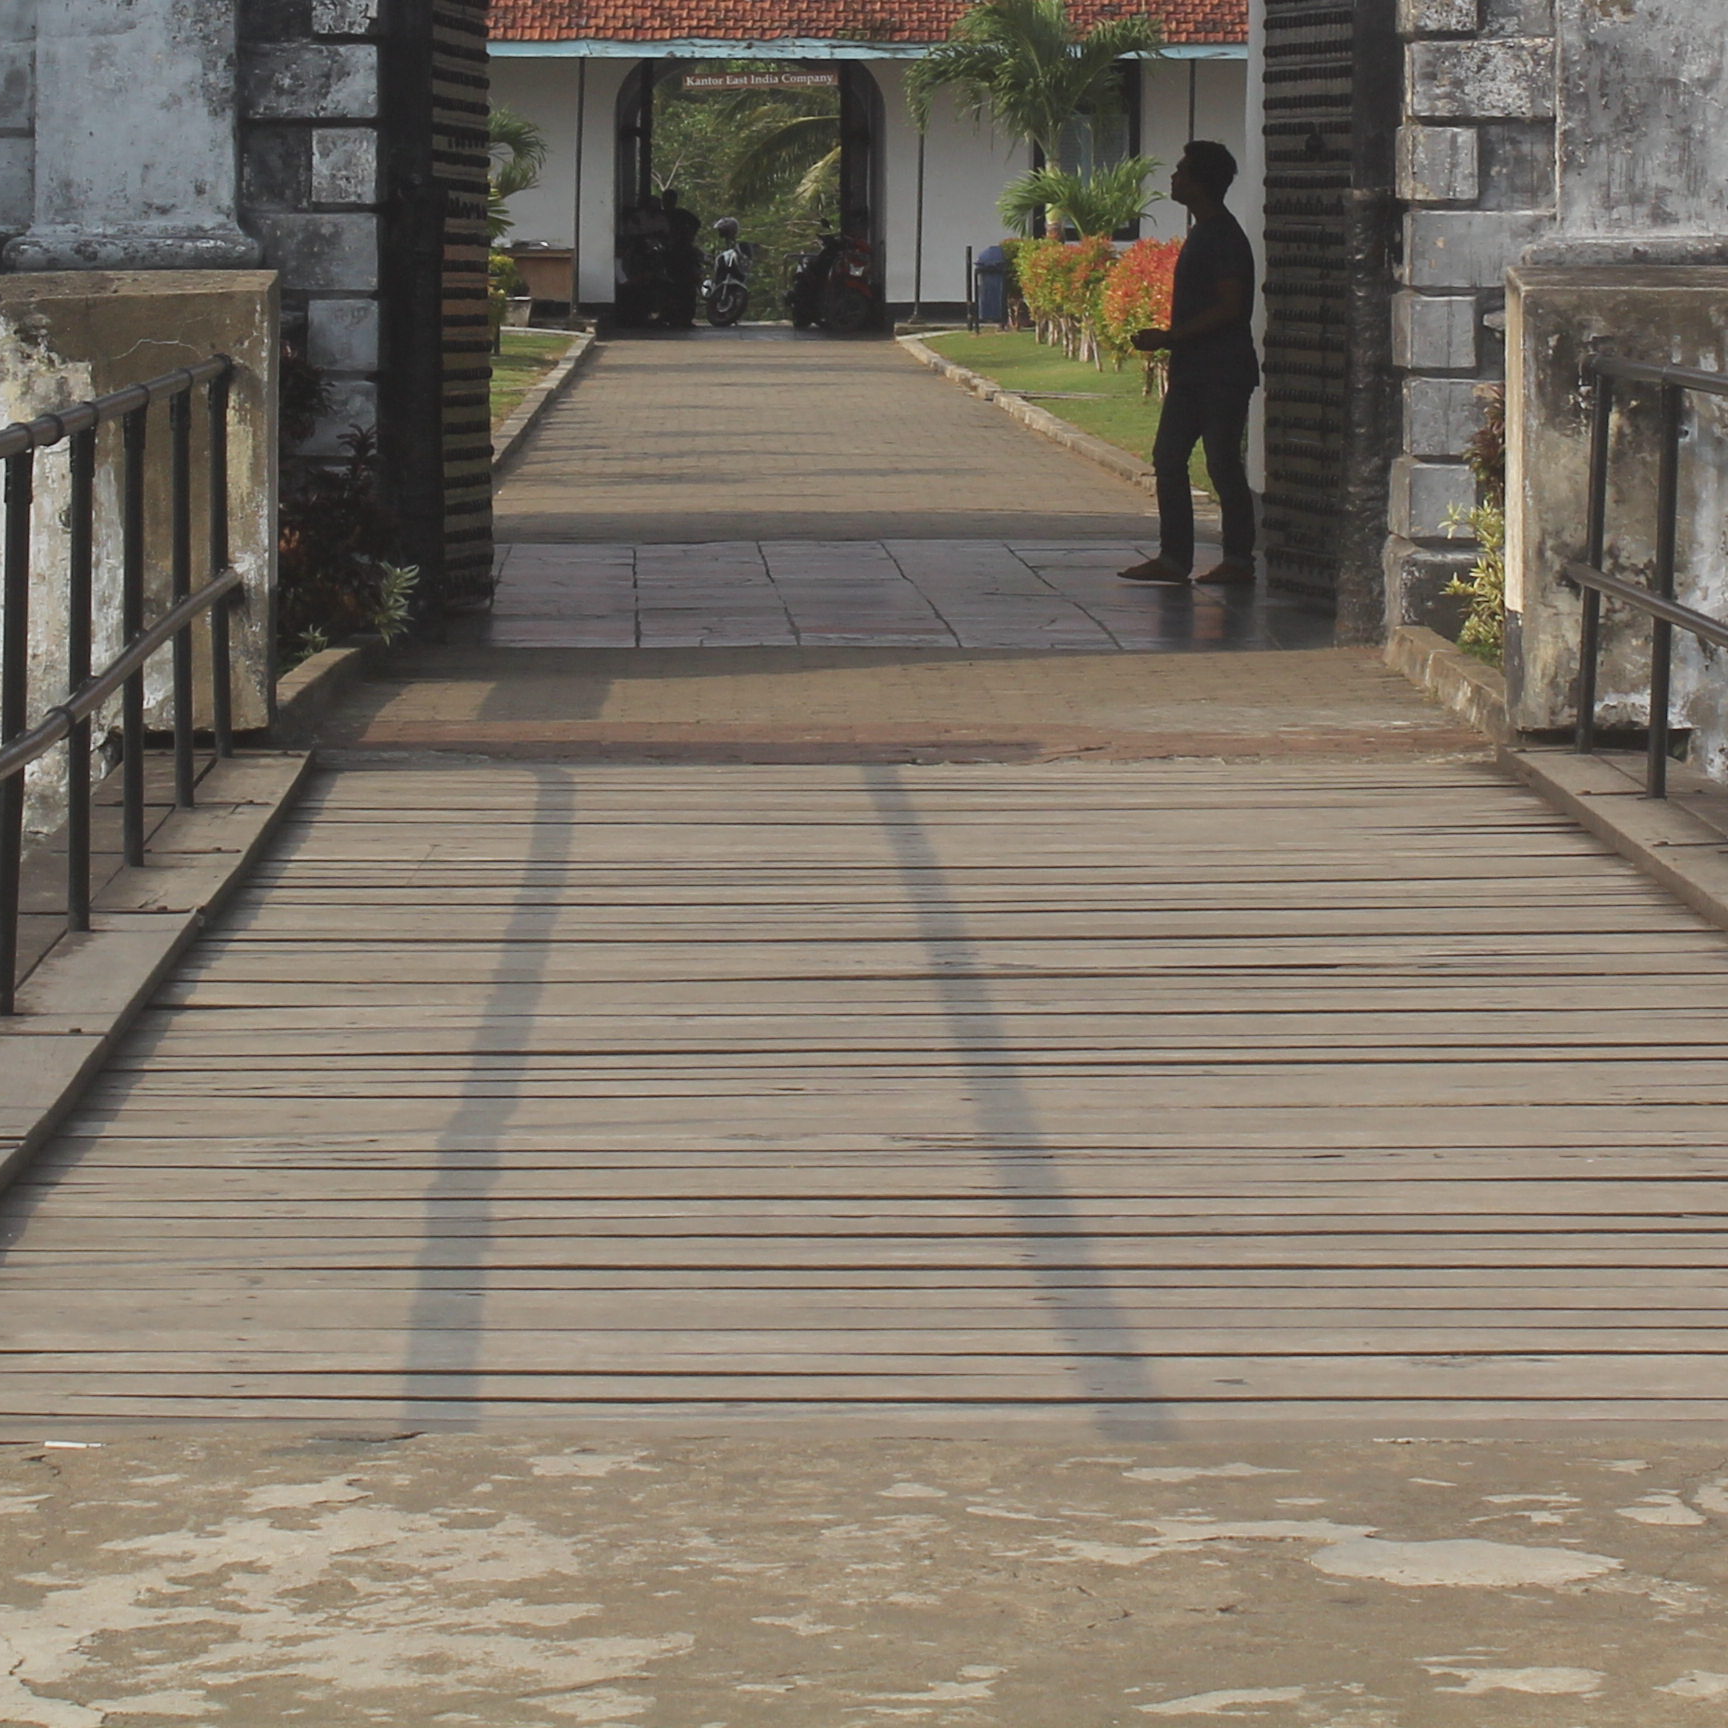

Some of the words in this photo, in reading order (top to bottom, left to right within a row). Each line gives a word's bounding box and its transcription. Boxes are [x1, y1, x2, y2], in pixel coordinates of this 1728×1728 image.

[685, 75, 723, 85] Kantor
[725, 75, 748, 83] East
[751, 73, 778, 83] India
[781, 71, 833, 83] Company
